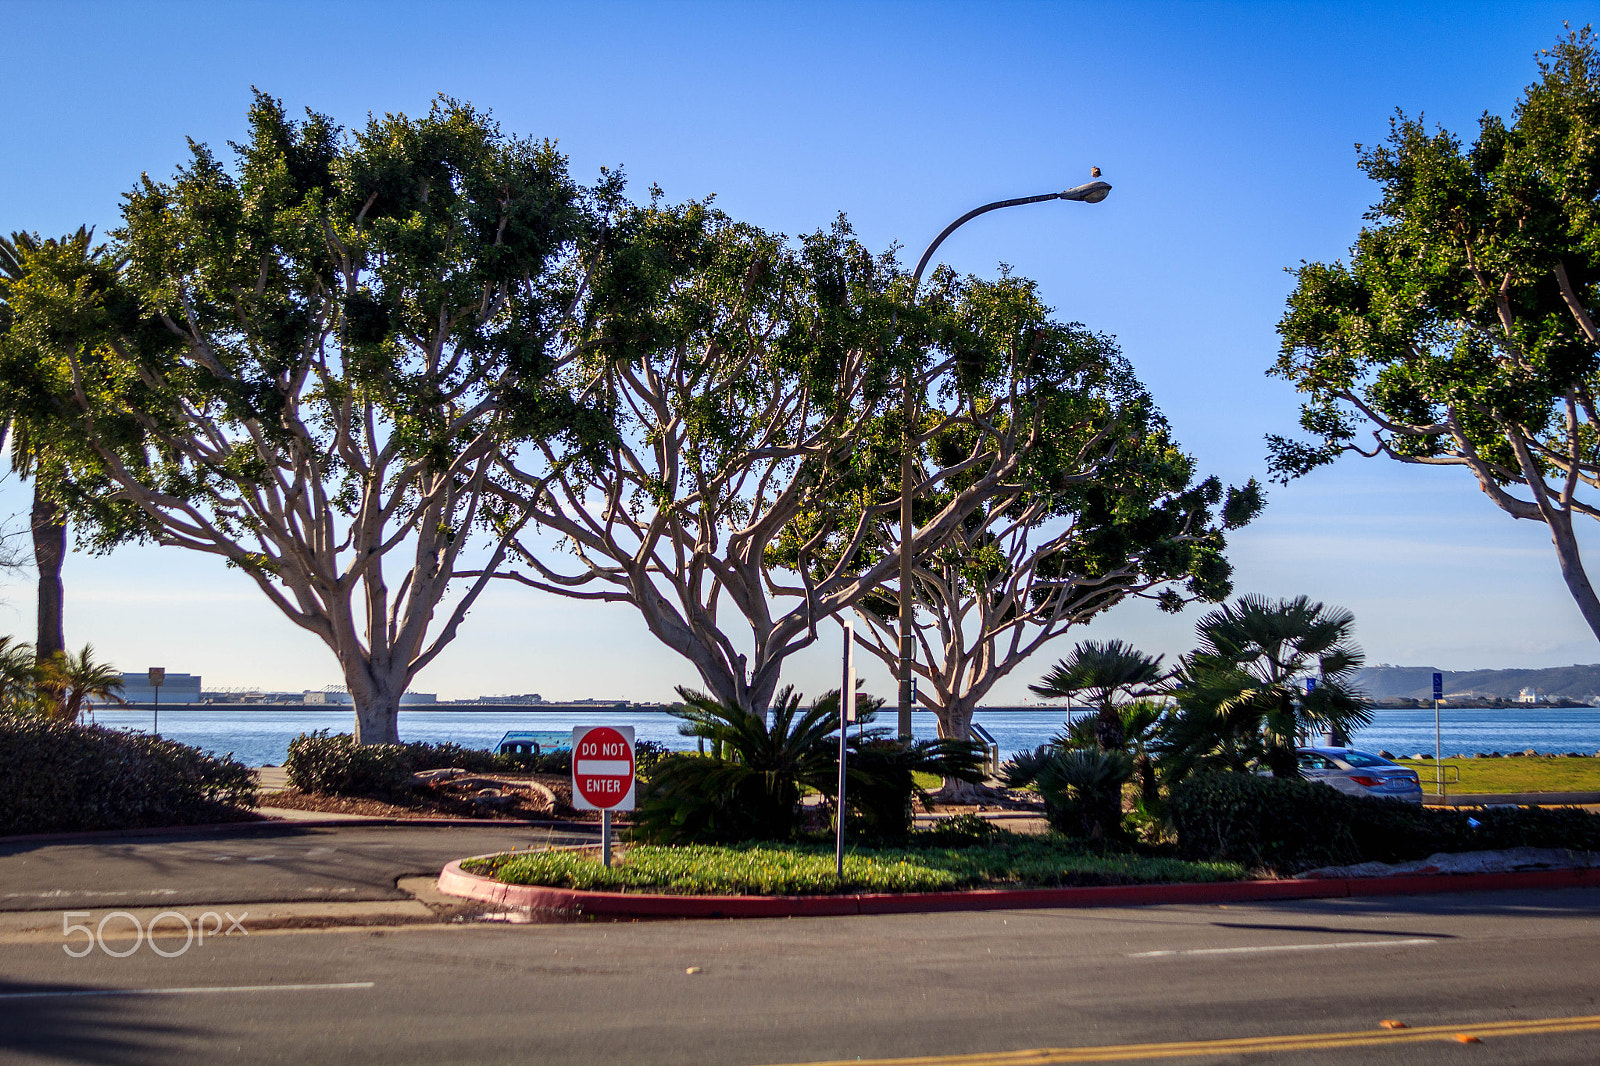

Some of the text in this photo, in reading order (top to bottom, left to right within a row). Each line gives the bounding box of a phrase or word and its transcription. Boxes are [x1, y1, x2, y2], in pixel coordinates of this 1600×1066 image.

[582, 743, 625, 756] DO NOT
[586, 779, 621, 793] ENTER
